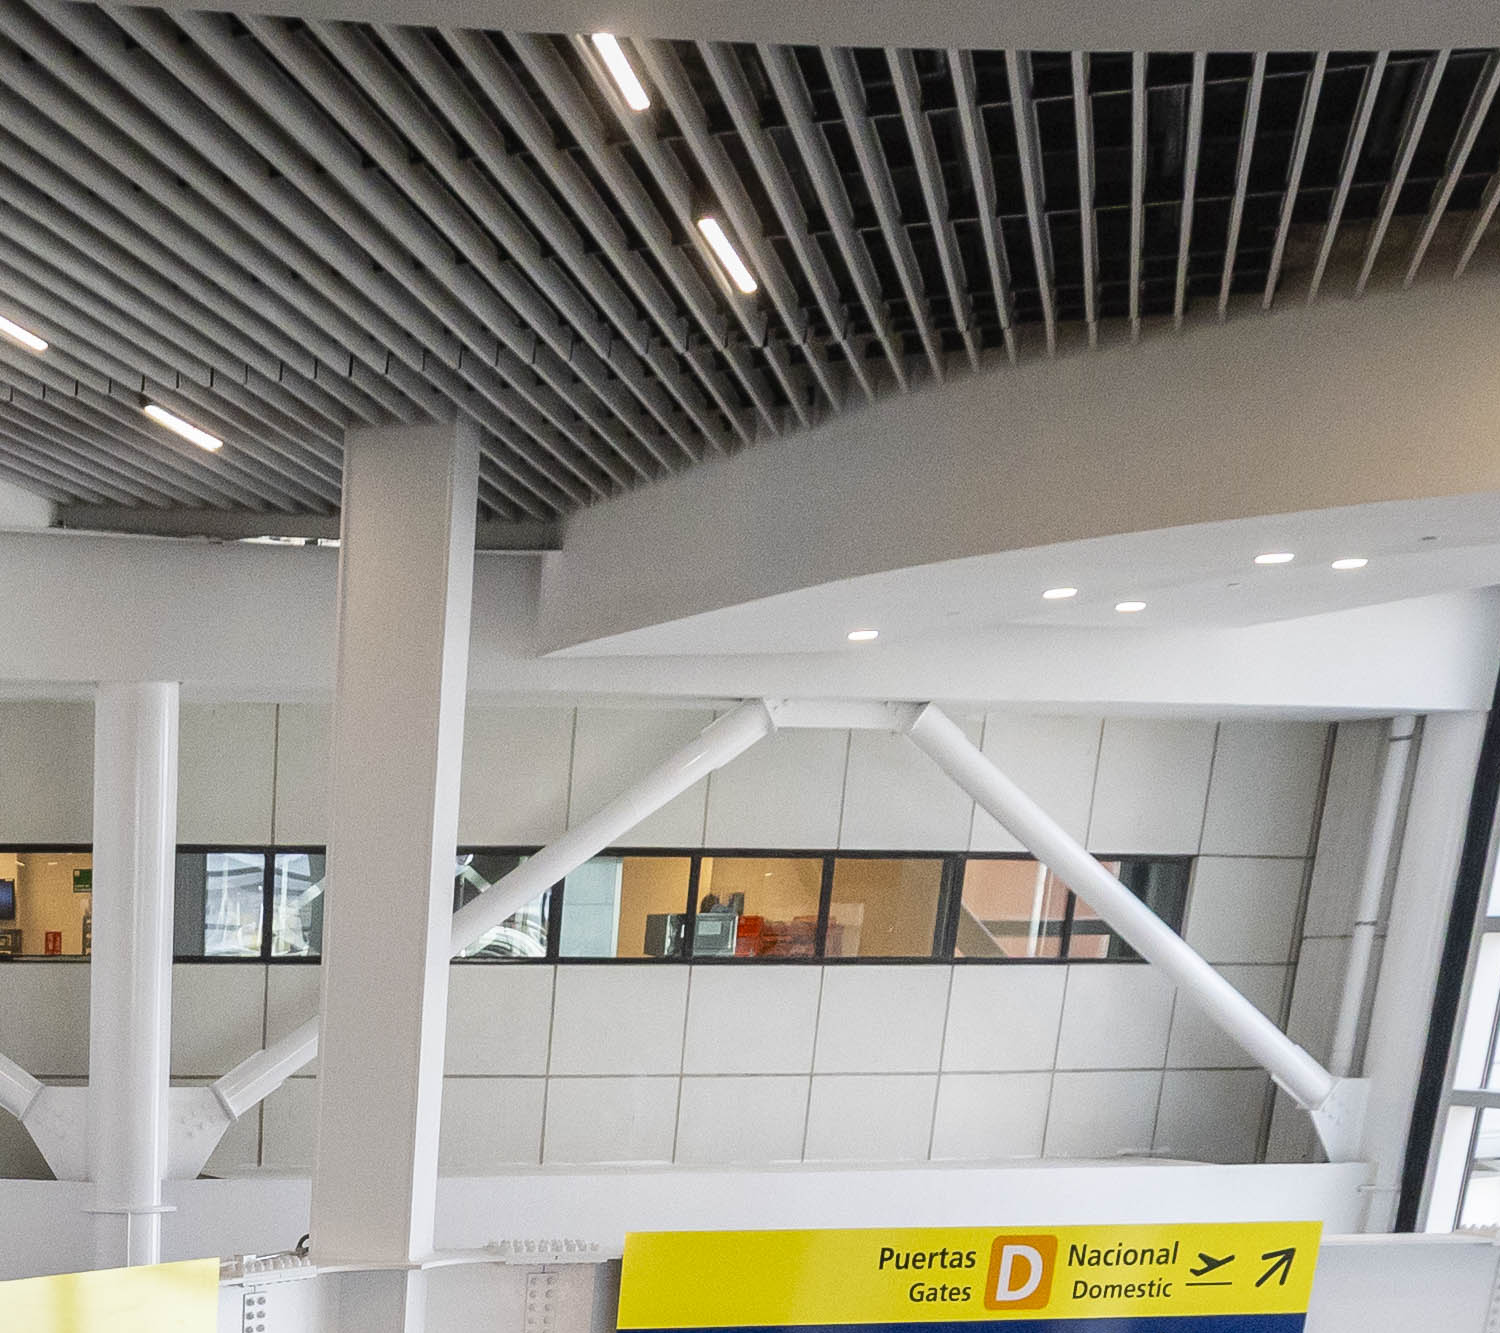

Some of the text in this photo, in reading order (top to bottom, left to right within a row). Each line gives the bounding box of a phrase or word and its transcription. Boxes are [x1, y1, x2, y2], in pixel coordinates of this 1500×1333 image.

[879, 1247, 976, 1270] Puertas
[1068, 1241, 1179, 1266] Nacional
[996, 1245, 1043, 1301] D
[909, 1282, 971, 1303] Gates
[1072, 1279, 1172, 1299] Domestic
